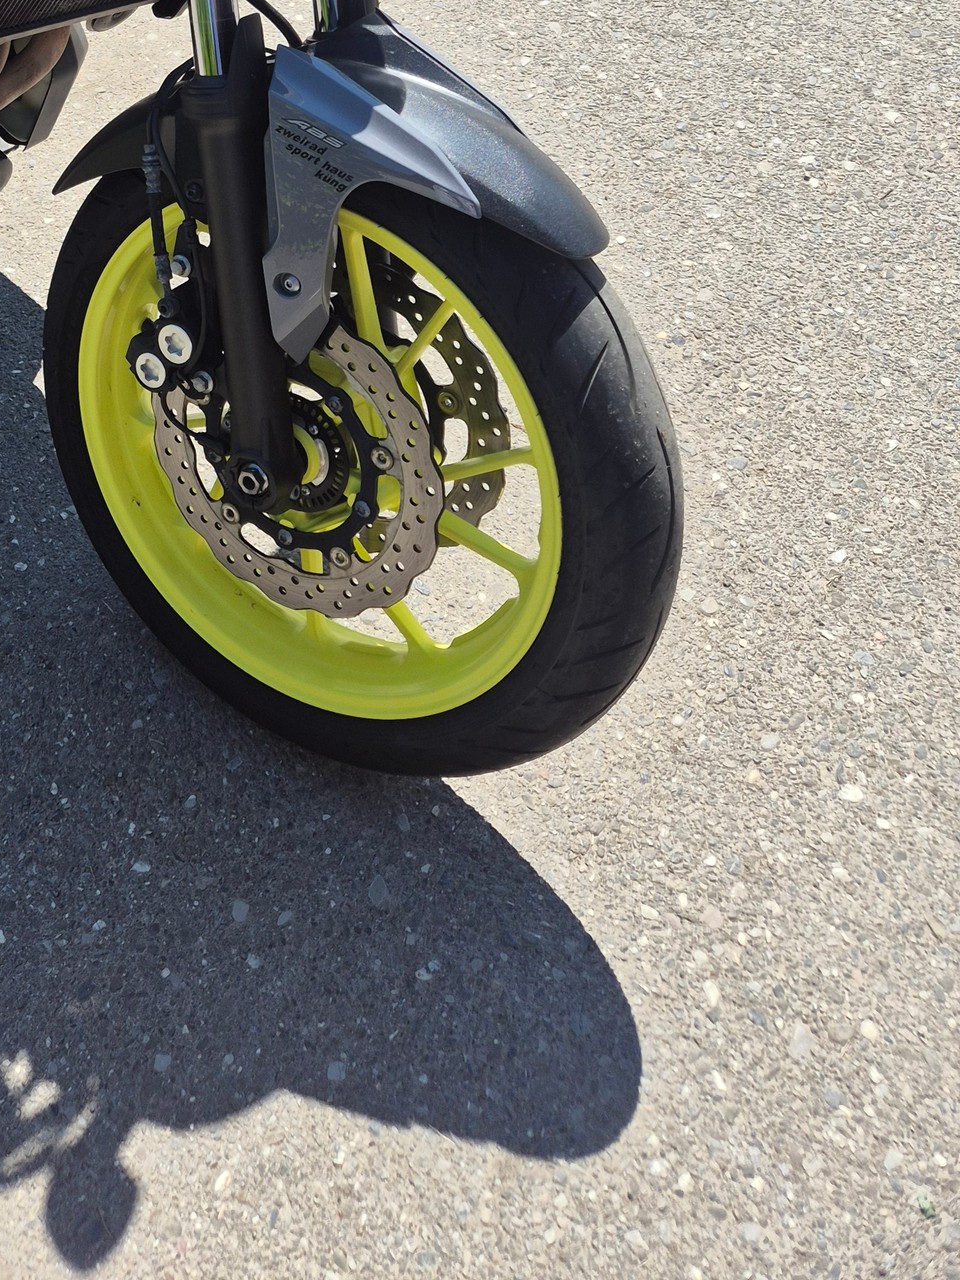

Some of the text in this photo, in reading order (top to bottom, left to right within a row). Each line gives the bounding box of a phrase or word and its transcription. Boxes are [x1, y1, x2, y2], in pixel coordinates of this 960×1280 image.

[275, 125, 328, 156] zweirad
[281, 118, 347, 149] ABS
[285, 143, 355, 183] sport haus
[314, 169, 348, 193] küng
